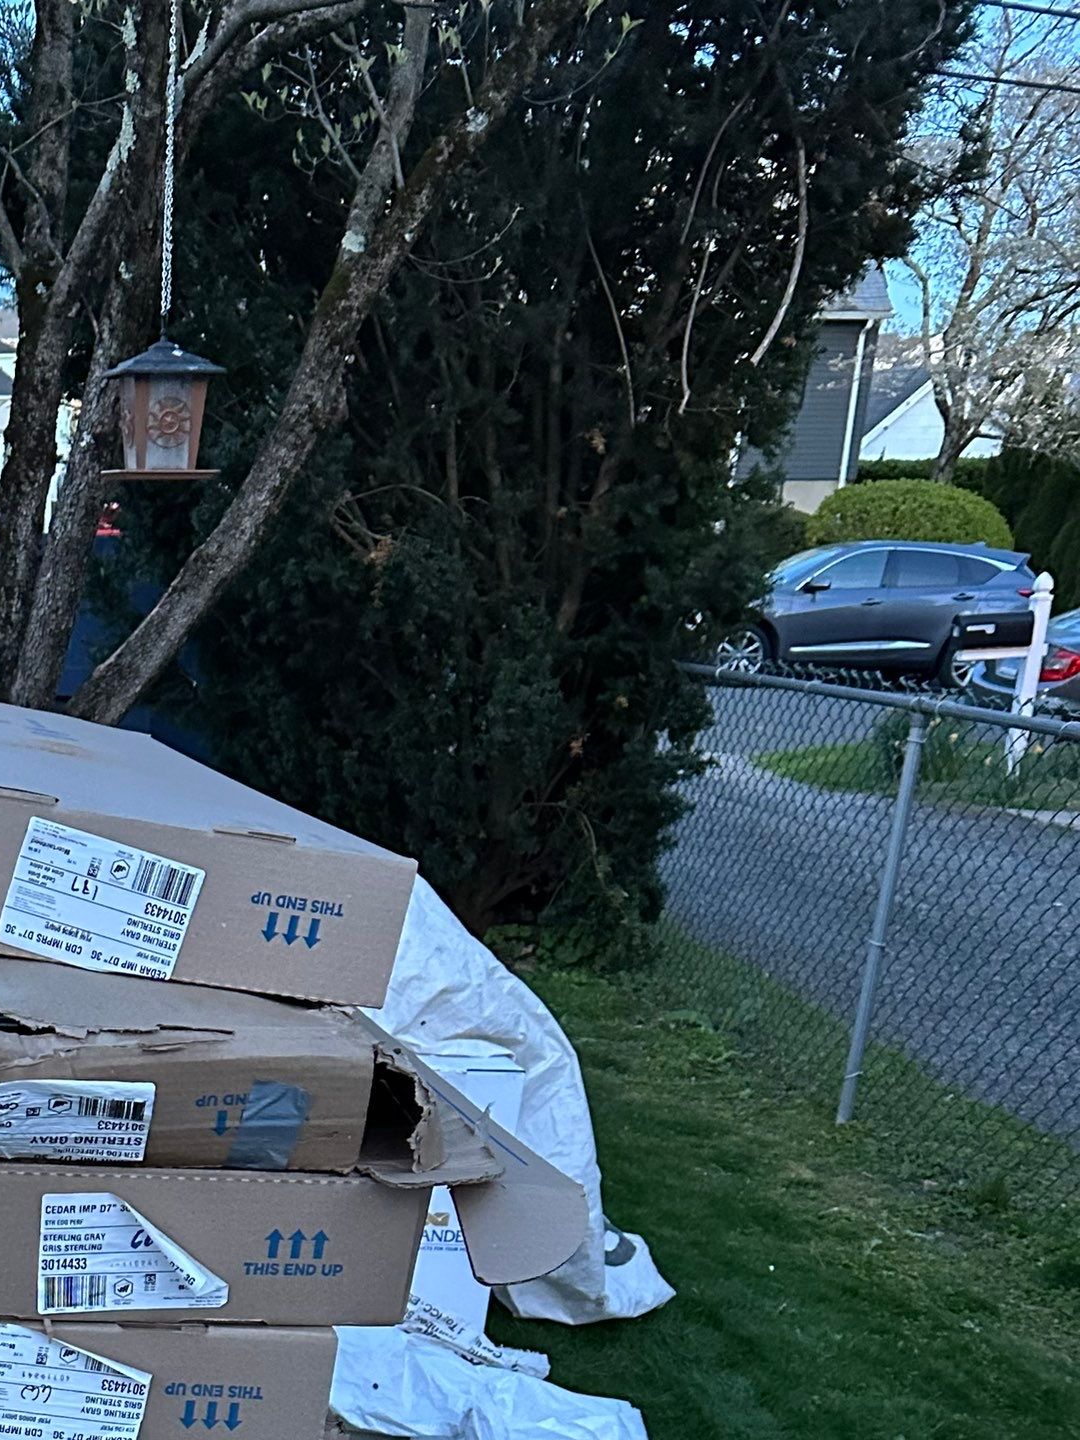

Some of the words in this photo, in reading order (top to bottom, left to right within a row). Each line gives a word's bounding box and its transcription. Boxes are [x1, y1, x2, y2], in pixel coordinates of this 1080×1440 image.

[250, 890, 271, 906] UP
[275, 894, 307, 911] END
[143, 902, 187, 925] 3014433
[310, 899, 344, 917] THIS
[126, 917, 162, 934] STERLING
[35, 932, 63, 949] IMPRS
[162, 928, 181, 940] GRIS
[64, 941, 83, 955] CDR
[141, 934, 177, 951] STERLING
[120, 959, 138, 971] IMP
[195, 1094, 217, 1107] UP
[223, 1093, 250, 1106] ND
[74, 1135, 142, 1145] STERLING
[45, 1204, 75, 1214] CEDAR
[79, 1204, 96, 1213] IMP
[43, 1233, 81, 1242] STERLING
[42, 1244, 61, 1252] GRIS
[41, 1256, 87, 1271] 3014433
[244, 1262, 279, 1275] THIS
[284, 1263, 316, 1276] END
[320, 1263, 342, 1277] UP
[100, 1378, 145, 1395] 3014433
[164, 1381, 186, 1395] UP
[190, 1382, 223, 1397] END
[227, 1384, 263, 1399] THIS
[123, 1400, 142, 1410] GRIS
[103, 1408, 140, 1420] STERLING
[24, 1426, 42, 1437] CDR
